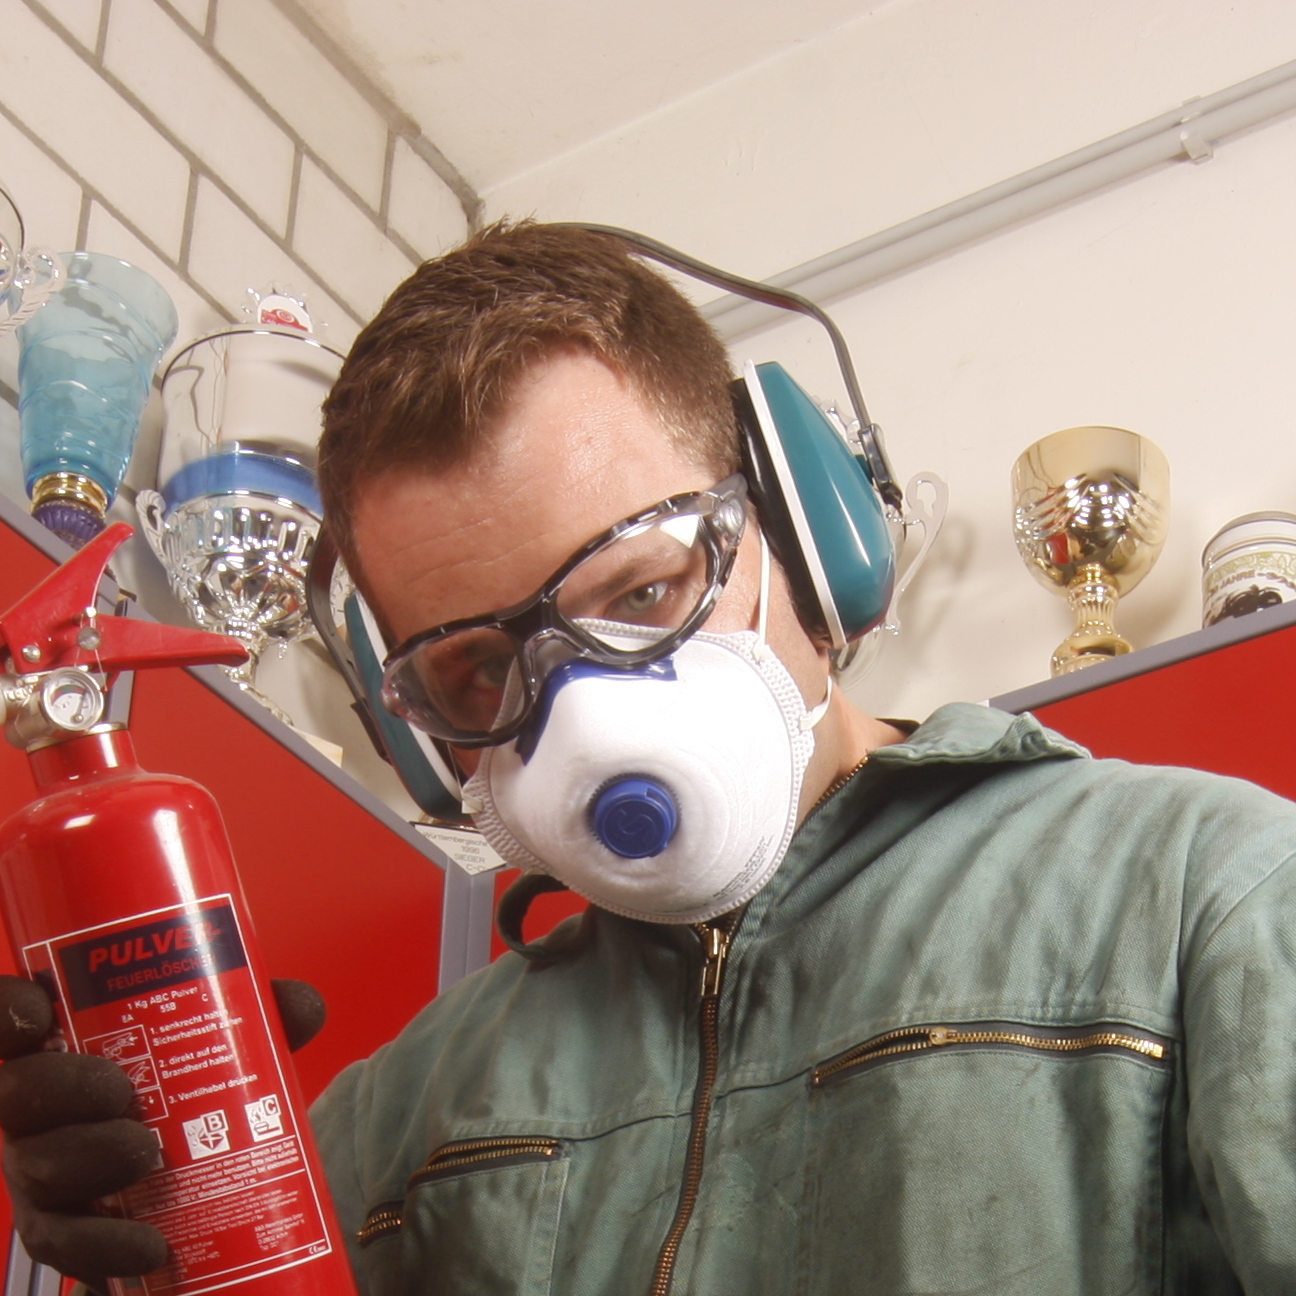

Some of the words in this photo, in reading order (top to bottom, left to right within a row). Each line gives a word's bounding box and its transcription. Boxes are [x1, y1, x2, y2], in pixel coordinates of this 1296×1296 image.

[107, 954, 215, 989] FEUERLÖSCHER
[134, 999, 148, 1010] Kg
[150, 992, 169, 1005] ABC
[171, 986, 198, 999] Pulver
[153, 1023, 217, 1047] Sicherheitsstift
[160, 1016, 203, 1033] senkrecht
[159, 1059, 167, 1068] 2.
[169, 1052, 194, 1065] direkt
[196, 1047, 210, 1058] auf
[211, 1043, 227, 1053] den
[162, 1060, 209, 1079] Brandherd
[209, 1053, 234, 1067] halten
[169, 1095, 178, 1104] 3.
[178, 1081, 227, 1101] Ventilhebel
[228, 1072, 258, 1088] drücken
